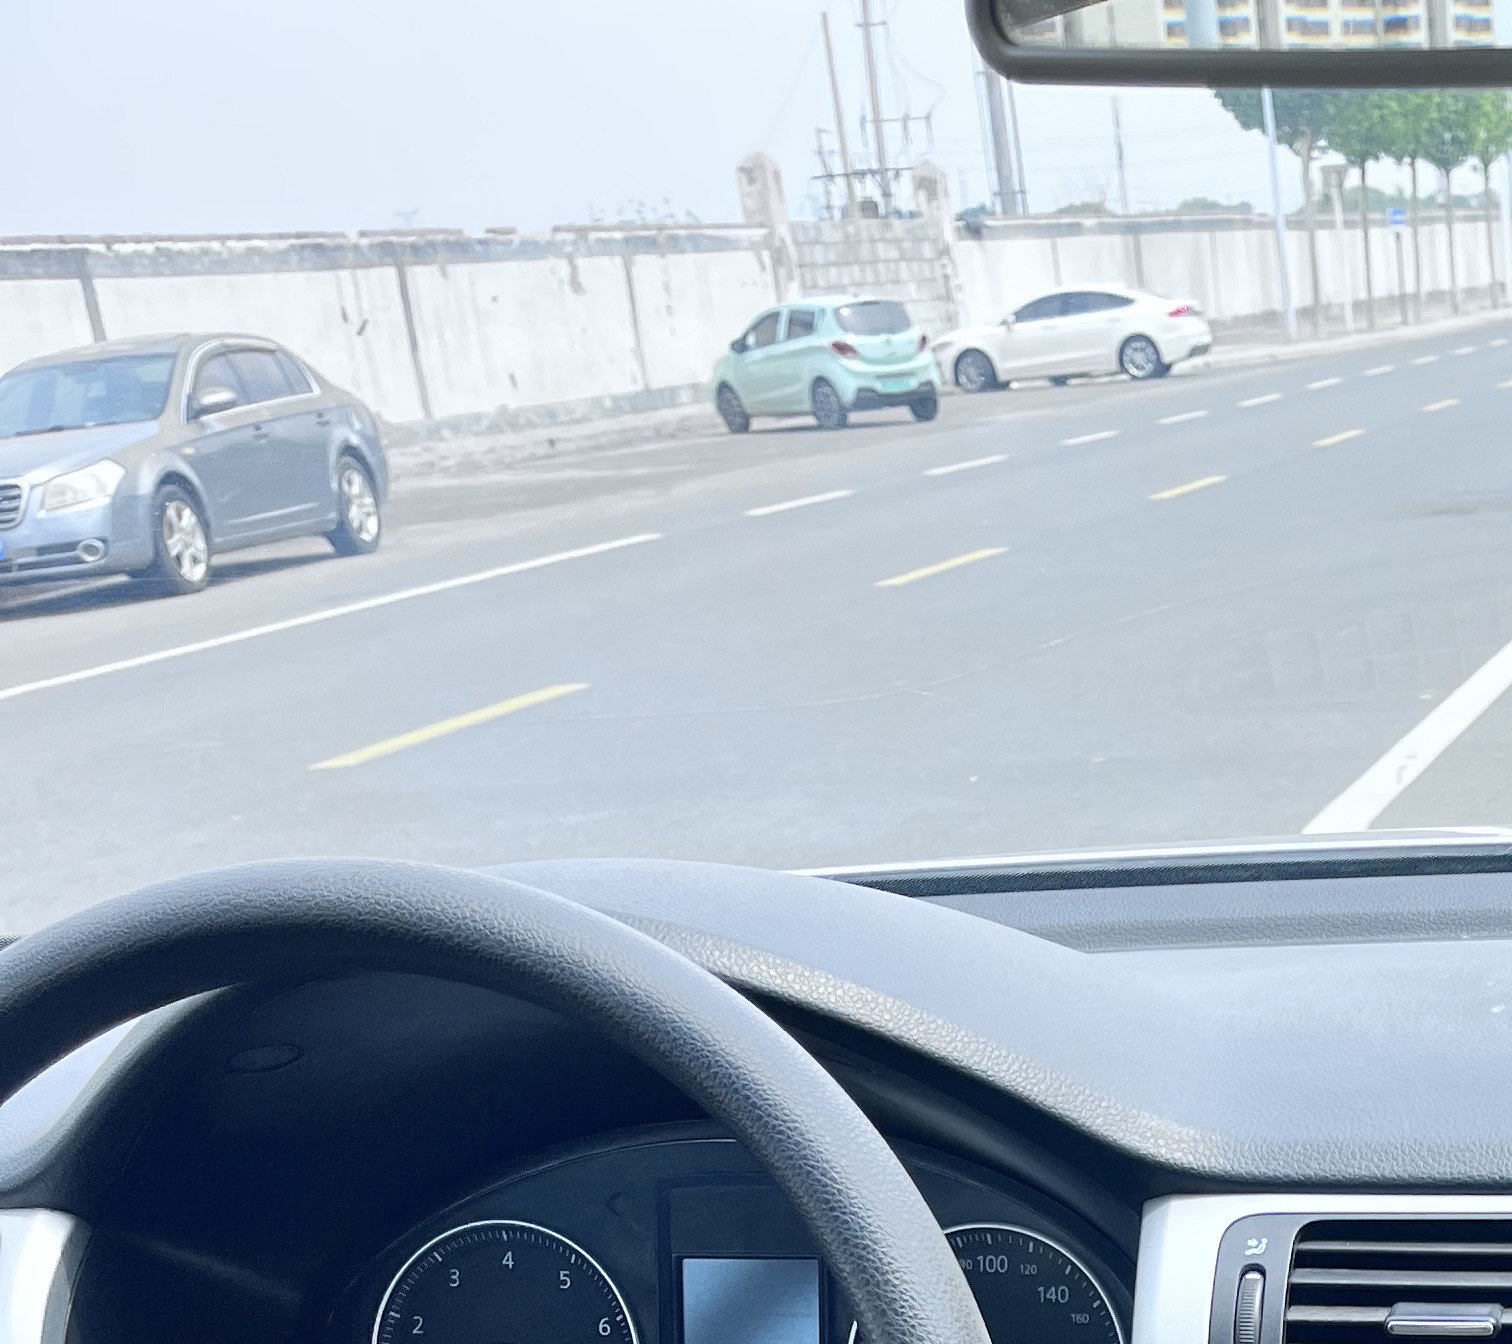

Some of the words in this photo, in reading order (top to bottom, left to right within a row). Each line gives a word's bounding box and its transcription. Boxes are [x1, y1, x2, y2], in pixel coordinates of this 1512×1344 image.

[502, 1251, 514, 1269] 4
[976, 1255, 1008, 1273] 100
[449, 1269, 460, 1287] 3
[1020, 1264, 1037, 1275] 120
[559, 1271, 571, 1289] 5
[1038, 1285, 1069, 1303] 140
[412, 1316, 424, 1334] 2
[598, 1317, 611, 1335] 6
[1070, 1313, 1090, 1324] 160
